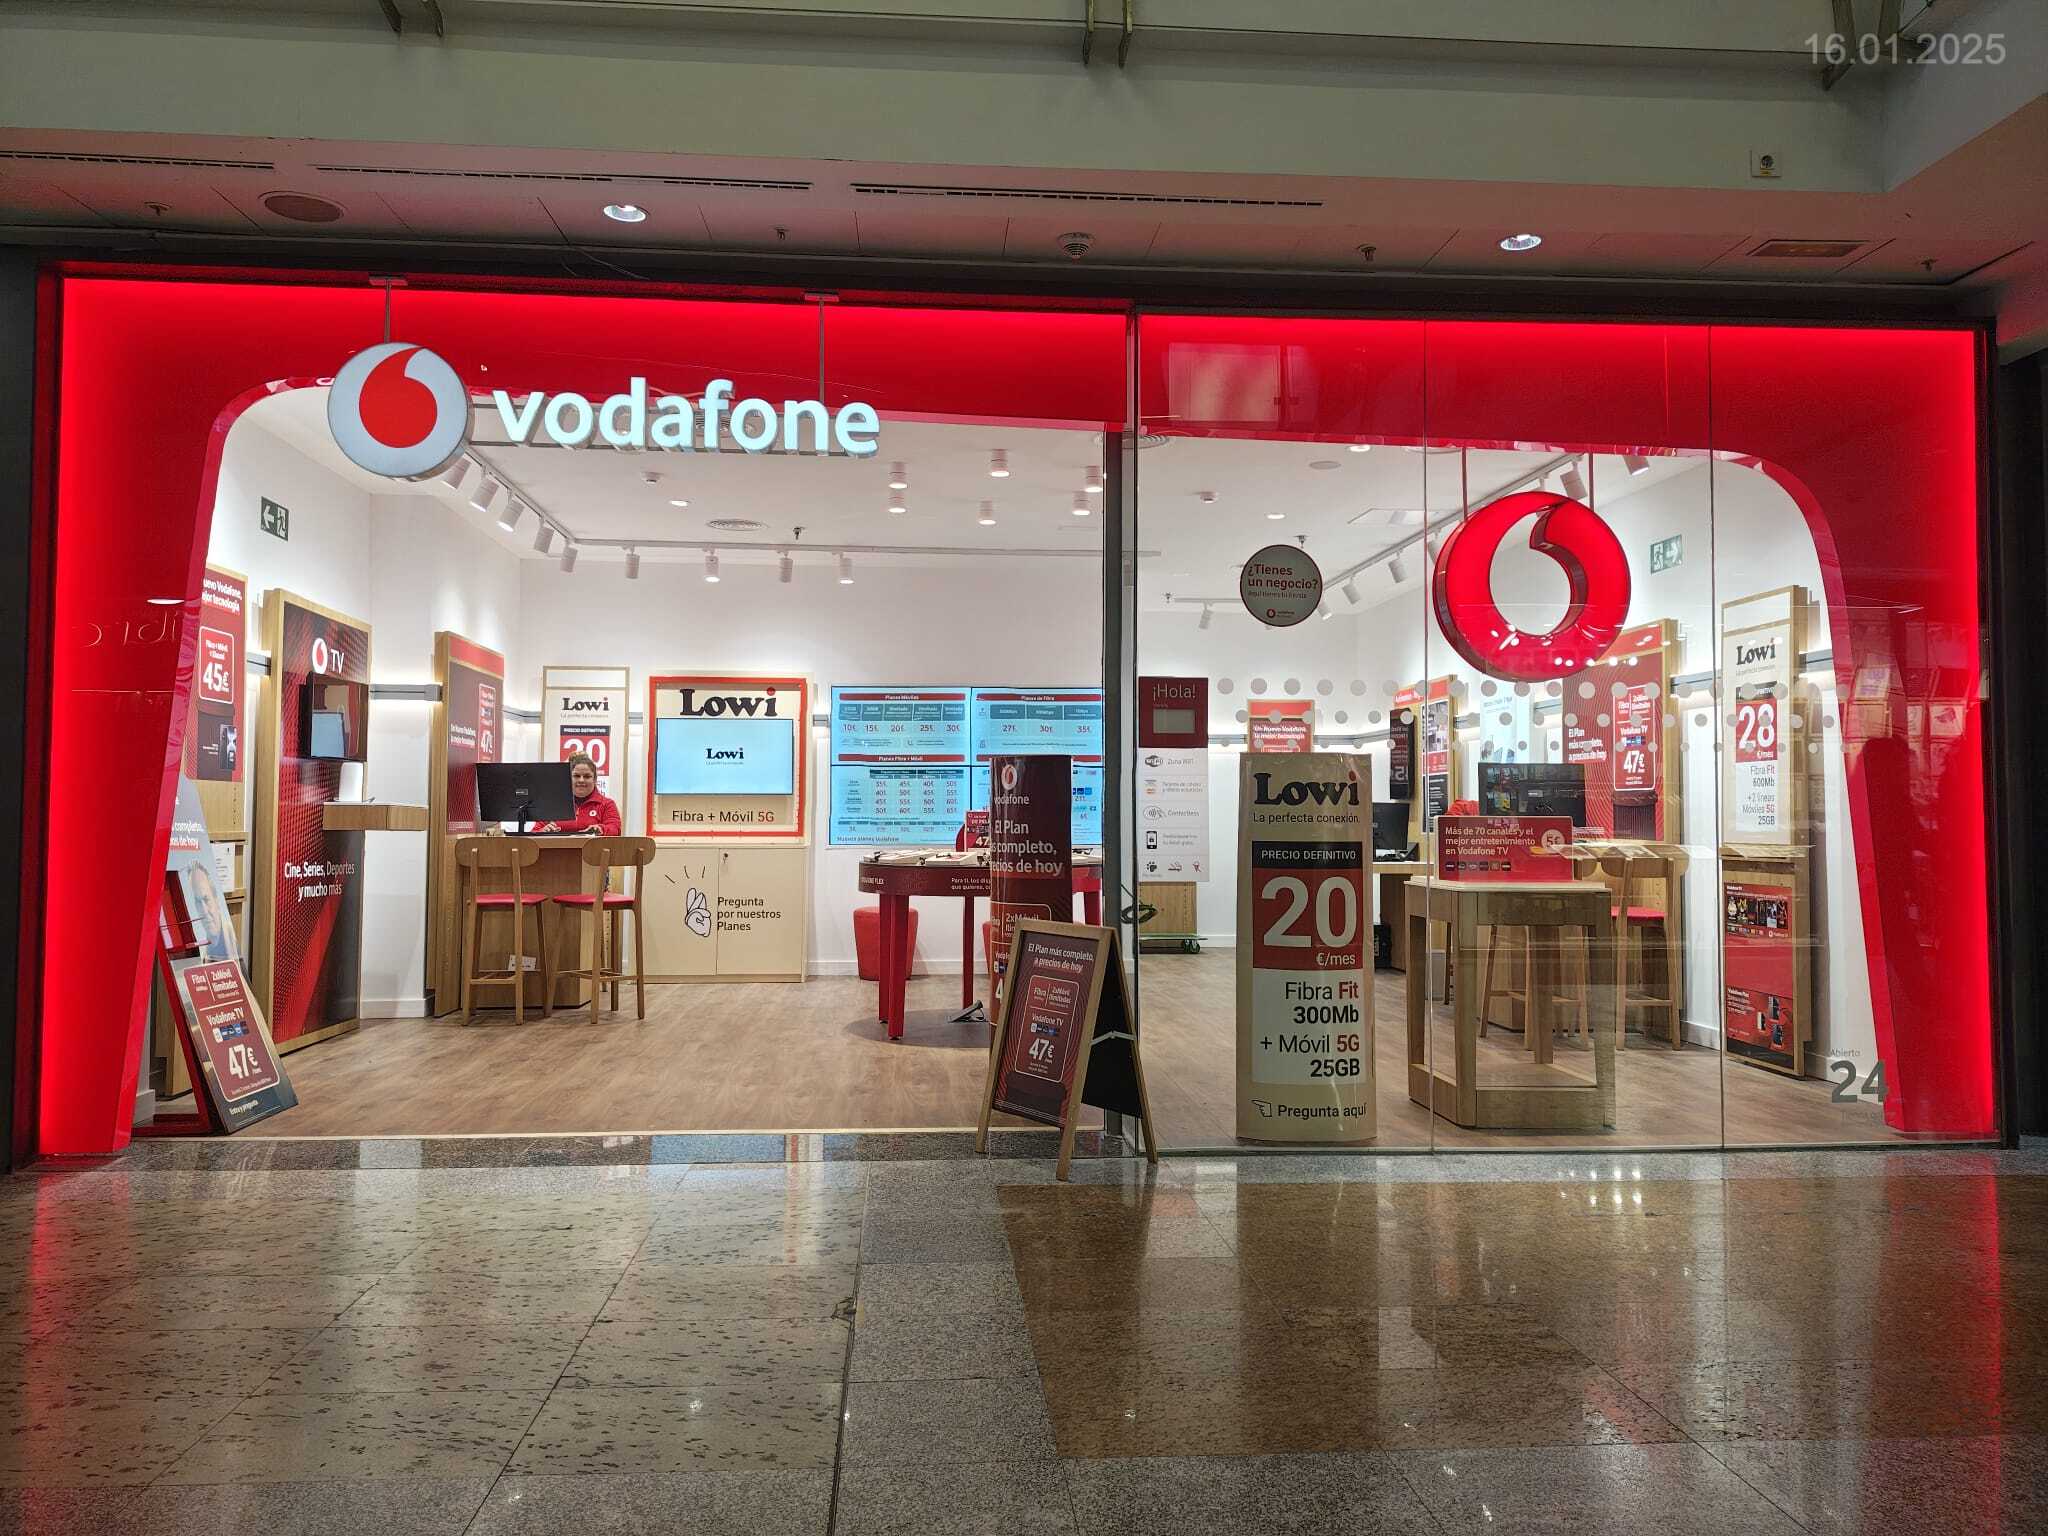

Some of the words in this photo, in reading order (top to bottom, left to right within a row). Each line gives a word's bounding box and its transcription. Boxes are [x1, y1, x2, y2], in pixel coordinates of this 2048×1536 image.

[492, 376, 881, 456] vodafone
[1248, 564, 1293, 576] ¿Tienes
[1266, 579, 1319, 591] negocio?
[1736, 637, 1776, 665] Lowi
[330, 649, 345, 674] TV
[1153, 683, 1196, 701] ¡Hola!
[561, 697, 610, 711] Lowi
[679, 687, 777, 717] Lowi
[705, 747, 744, 760] Lowi
[1254, 770, 1360, 806] Lowi
[994, 793, 1030, 805] vodafone
[672, 810, 704, 822] Fibra
[719, 809, 753, 823] Móvil
[757, 811, 775, 823] 5G
[1253, 812, 1265, 823] La
[1267, 812, 1314, 825] perfecta
[995, 820, 1002, 834] El
[1003, 820, 1029, 834] Plan
[1445, 826, 1462, 835] Más
[1463, 827, 1473, 835] de
[1475, 827, 1485, 835] 70
[1525, 827, 1534, 835] el
[997, 840, 1057, 857] completo,
[1445, 838, 1468, 847] mejor
[1470, 837, 1536, 846] entretenimiento
[1261, 849, 1300, 860] PRECIO
[1303, 849, 1356, 860] DEFINITIVO
[1458, 846, 1496, 855] Vodafone
[1496, 847, 1509, 855] TV
[284, 861, 303, 879] Cine,
[303, 861, 326, 878] Series,
[326, 860, 355, 878] Deportes
[1016, 859, 1032, 872] de
[1035, 859, 1064, 877] hoy
[298, 886, 304, 902] y
[304, 881, 328, 897] mucho
[328, 880, 342, 895] más
[717, 896, 764, 908] Pregunta
[717, 910, 735, 920] por
[736, 910, 782, 919] nuestros
[1261, 876, 1358, 948] 20
[717, 921, 751, 931] Planes
[1028, 943, 1034, 952] El
[1034, 943, 1048, 954] Plan
[1049, 945, 1062, 956] más
[1038, 958, 1061, 968] precios
[1061, 960, 1070, 969] de
[1070, 962, 1084, 974] hoy
[1316, 952, 1356, 967] €/mes
[1285, 981, 1333, 1000] Fibra
[1338, 980, 1359, 999] Fit
[206, 1010, 235, 1025] Vodafone
[233, 1007, 244, 1019] TV
[1056, 1017, 1064, 1026] TV
[1293, 1005, 1359, 1024] 300Mb
[1028, 1038, 1055, 1060] 47€
[1260, 1036, 1273, 1050] +
[1279, 1033, 1330, 1053] Móvil
[1336, 1034, 1360, 1053] 5G
[229, 1044, 258, 1079] 47€
[1310, 1058, 1360, 1077] 25GB
[1277, 1104, 1340, 1120] Pregunta
[1343, 1102, 1367, 1118] aquí
